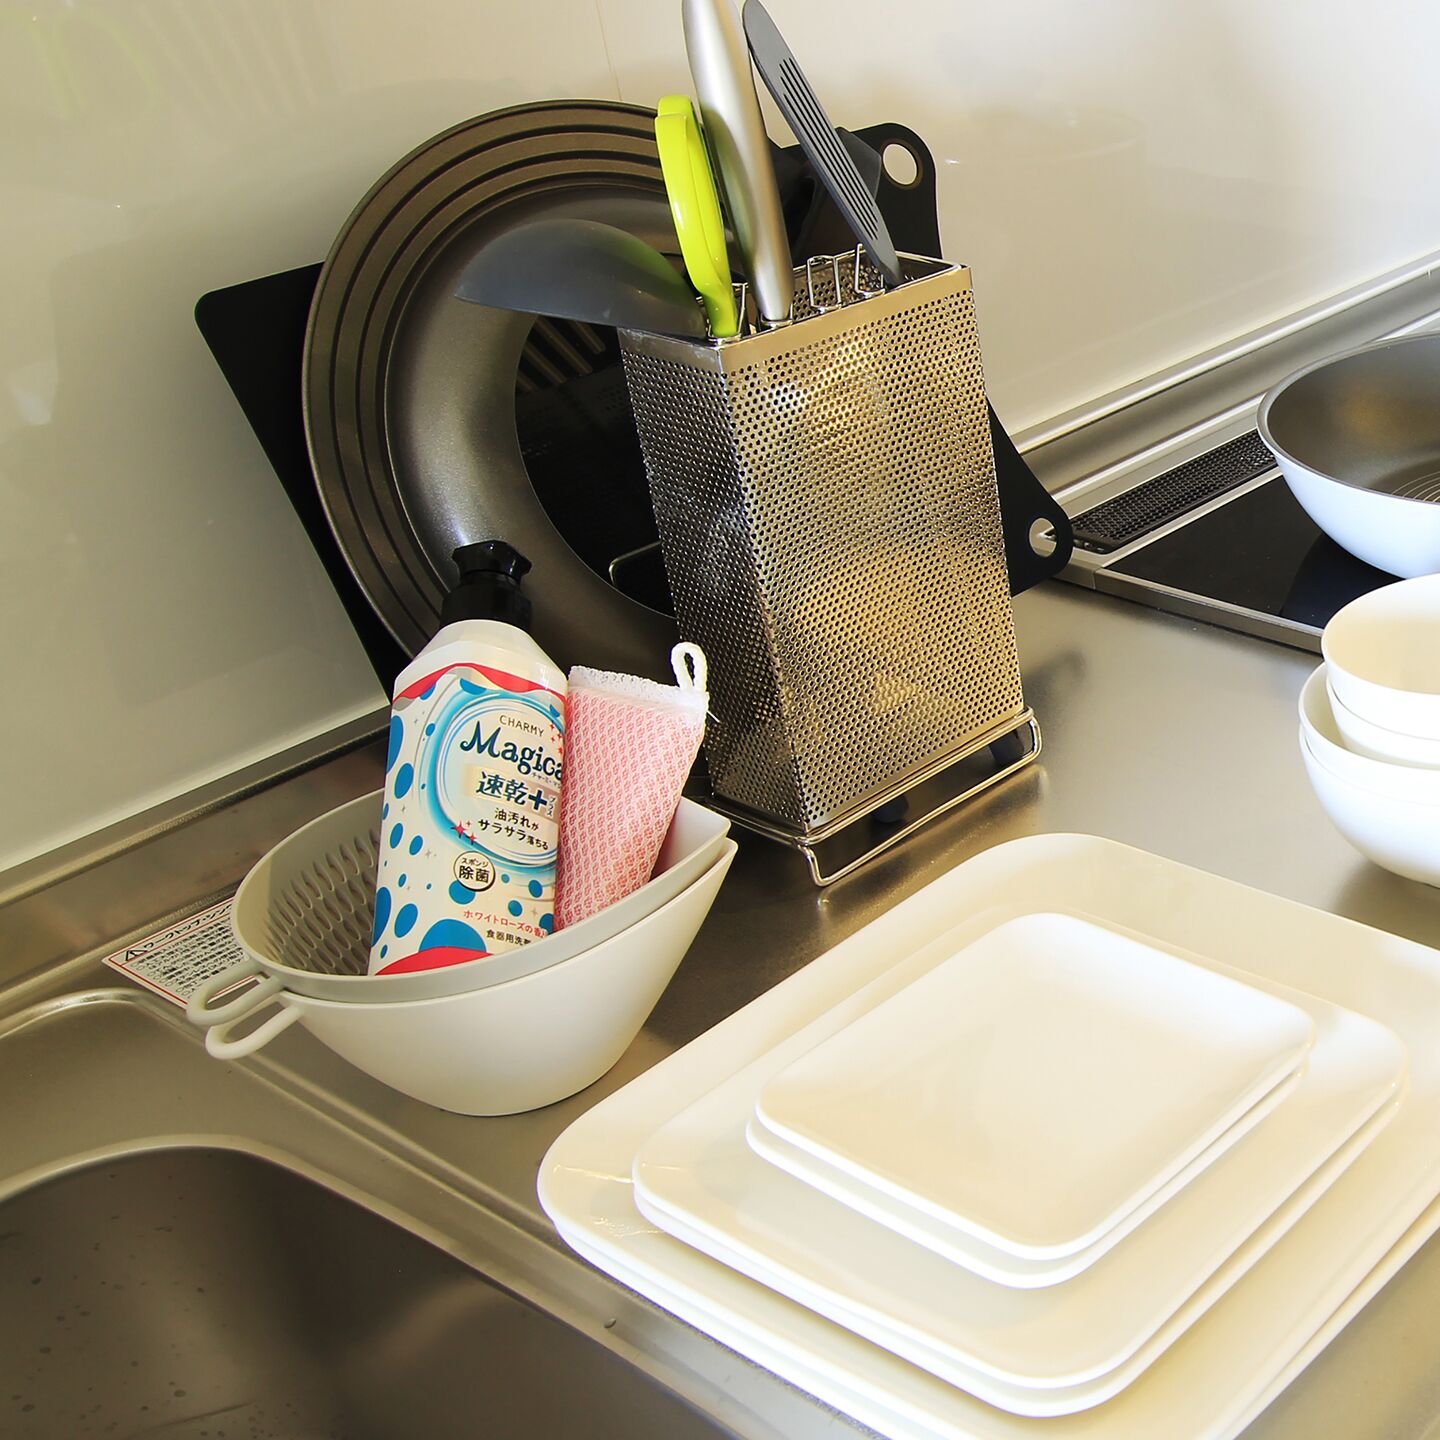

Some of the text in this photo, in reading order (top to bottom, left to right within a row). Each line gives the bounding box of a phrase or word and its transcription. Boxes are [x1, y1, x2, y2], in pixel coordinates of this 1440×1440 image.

[499, 714, 545, 738] CHARMY
[494, 807, 539, 831] 油汚れが
[478, 818, 550, 851] サラサラ落ちる
[458, 865, 491, 884] 除菌
[461, 857, 489, 868] スポンジ
